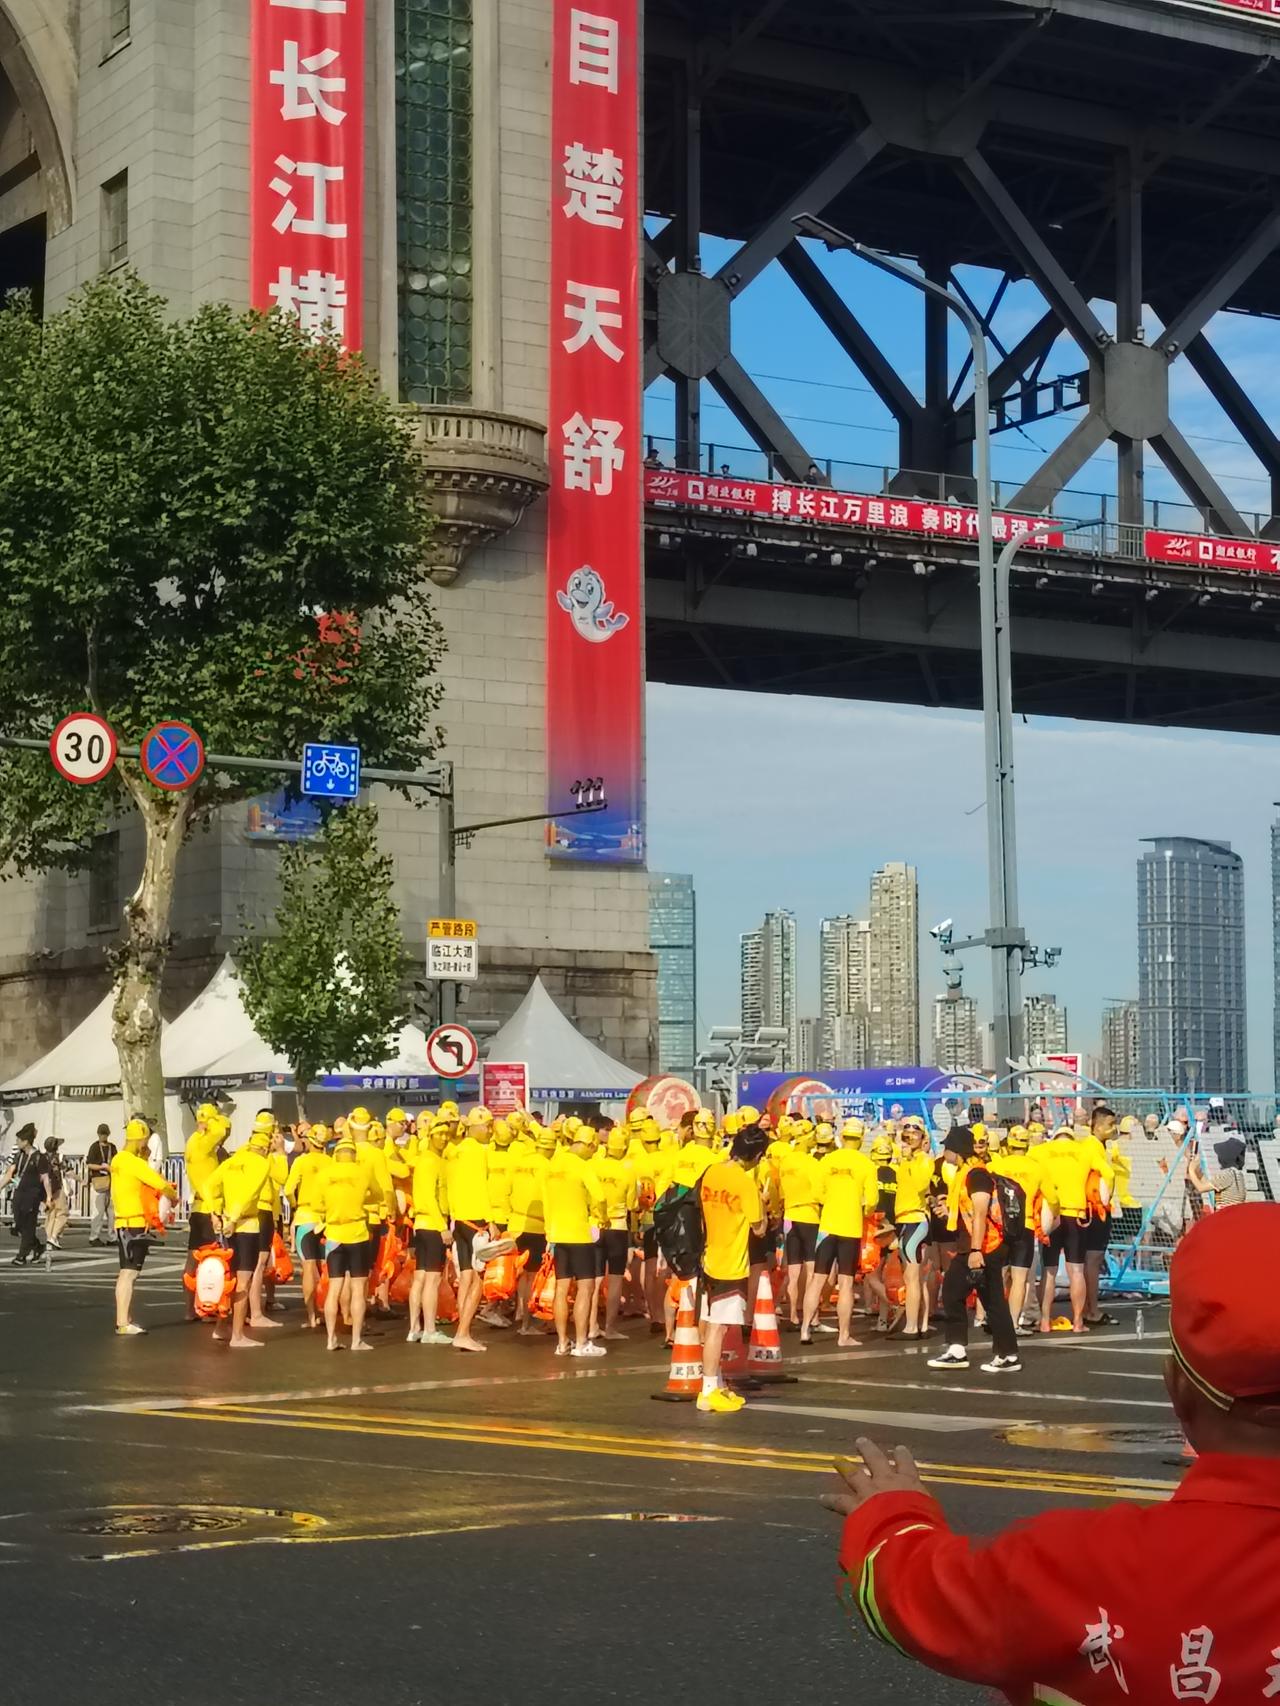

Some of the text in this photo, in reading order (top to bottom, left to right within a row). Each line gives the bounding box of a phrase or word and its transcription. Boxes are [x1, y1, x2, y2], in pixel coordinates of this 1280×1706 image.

[269, 0, 347, 351] 长江横
[561, 8, 625, 495] 目楚天舒
[64, 732, 105, 764] 30
